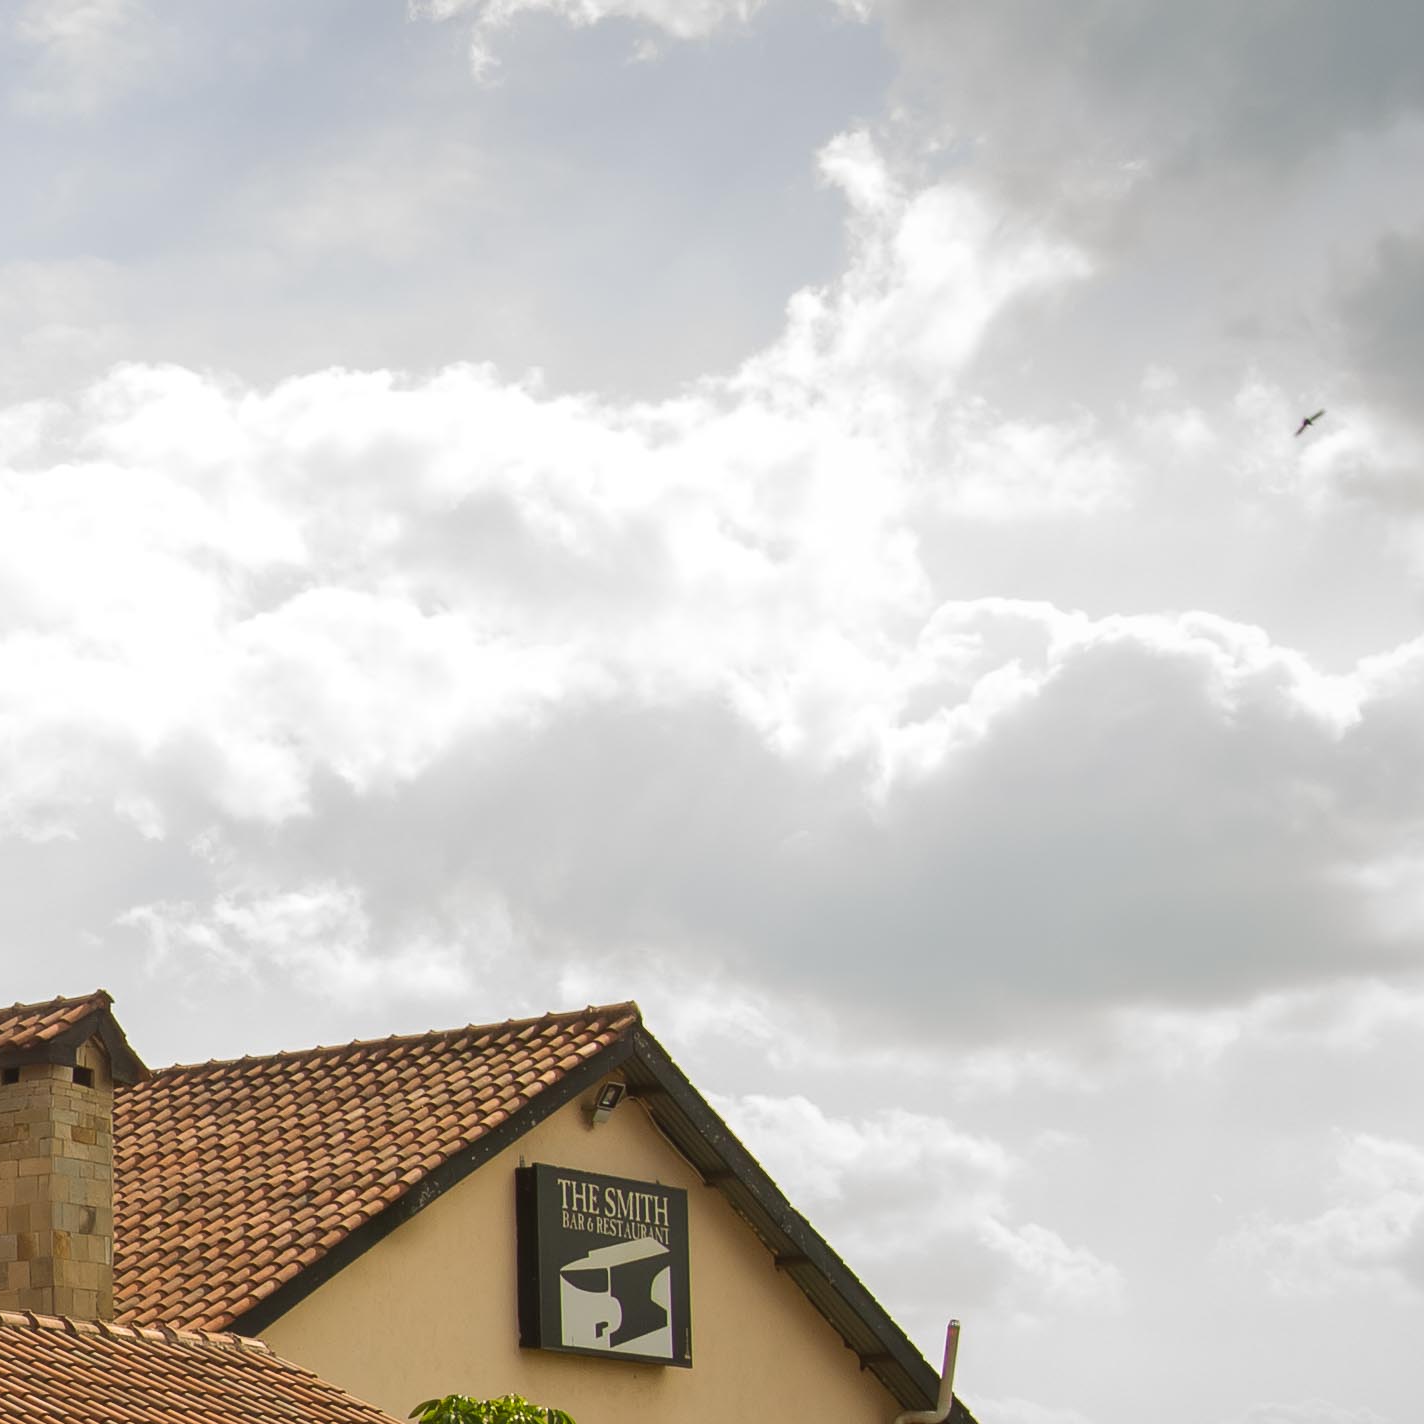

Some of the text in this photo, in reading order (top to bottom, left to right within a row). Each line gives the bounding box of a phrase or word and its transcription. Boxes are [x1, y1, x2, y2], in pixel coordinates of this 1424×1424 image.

[557, 1178, 670, 1227] THE SMITH
[562, 1210, 670, 1245] BAR & RESTAURANT
